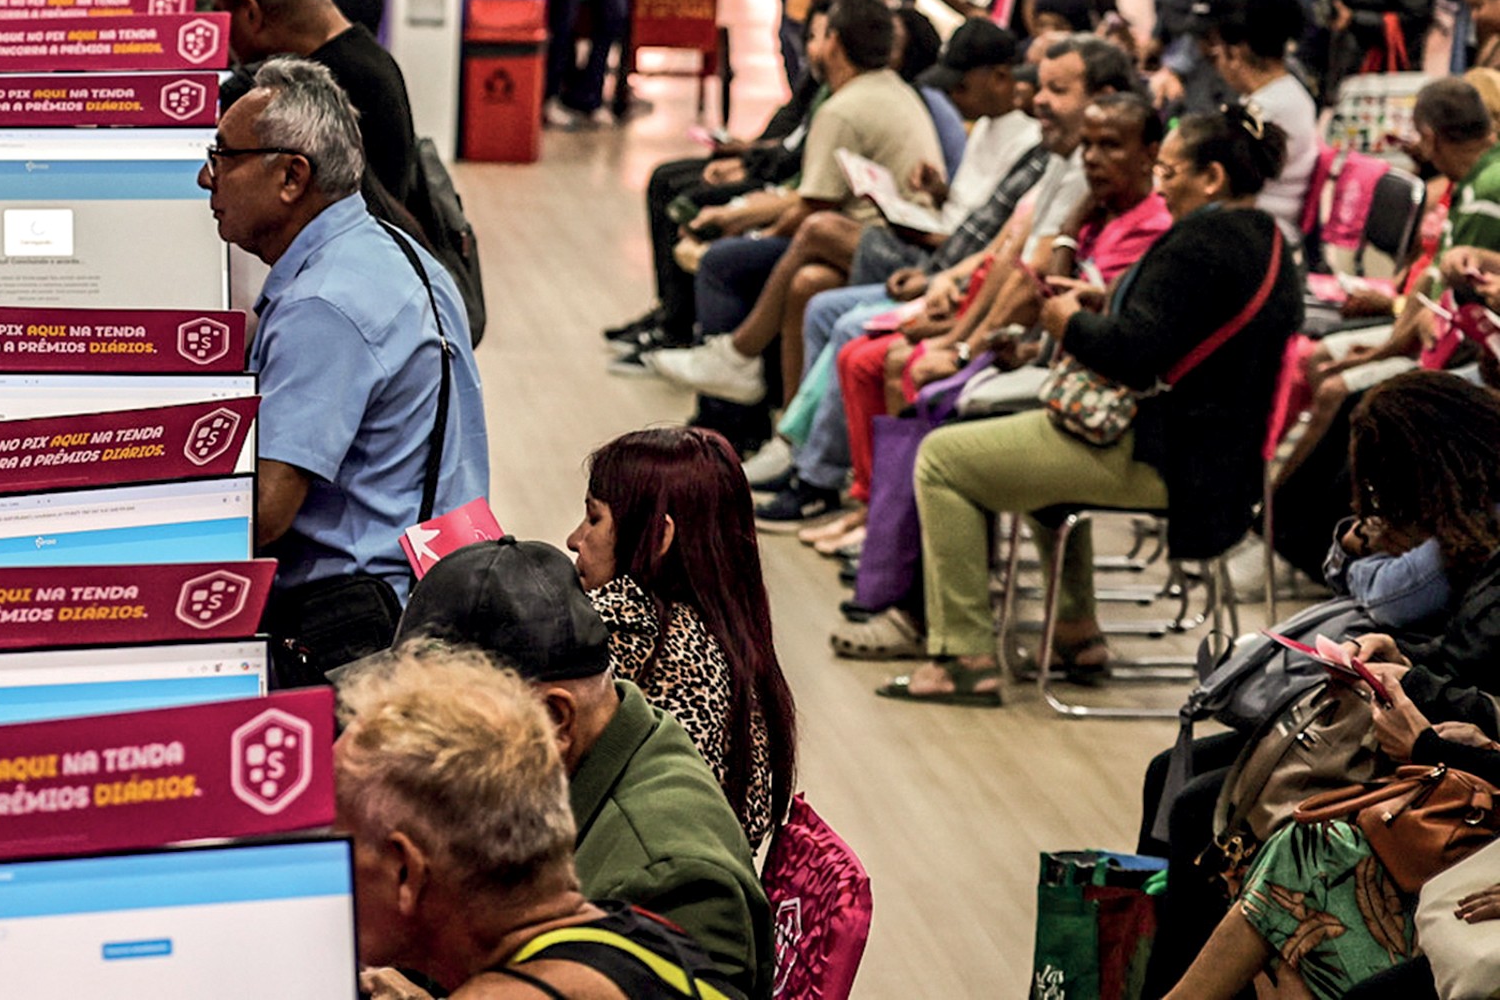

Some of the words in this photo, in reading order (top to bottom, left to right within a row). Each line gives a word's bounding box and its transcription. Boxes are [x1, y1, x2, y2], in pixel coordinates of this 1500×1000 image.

[8, 90, 30, 98] PIX
[33, 89, 67, 100] AQUI
[70, 89, 88, 98] NA
[91, 89, 134, 98] TENDA
[13, 102, 22, 111] A
[25, 99, 83, 111] PRÊMIOS
[86, 100, 144, 111] DIÁRIOS.
[26, 325, 67, 337] AQUI
[69, 326, 92, 336] NA
[94, 326, 146, 337] TENDA
[3, 341, 15, 352] A
[17, 338, 86, 353] PRÊMIOS
[89, 339, 158, 353] DIÁRIOS.
[20, 436, 50, 449] PIX
[49, 433, 91, 447] AQUI
[89, 431, 114, 444] NA
[115, 426, 164, 442] TENDA
[19, 455, 33, 467] A
[33, 449, 102, 466] PRÊMIOS
[101, 444, 166, 461] DIÁRIOS.
[35, 588, 67, 601] NA
[71, 586, 139, 600] TENDA
[57, 604, 149, 621] DIÁRIOS.
[62, 751, 100, 775] NA
[102, 741, 185, 772] TENDA
[93, 775, 203, 806] DIÁRIOS.
